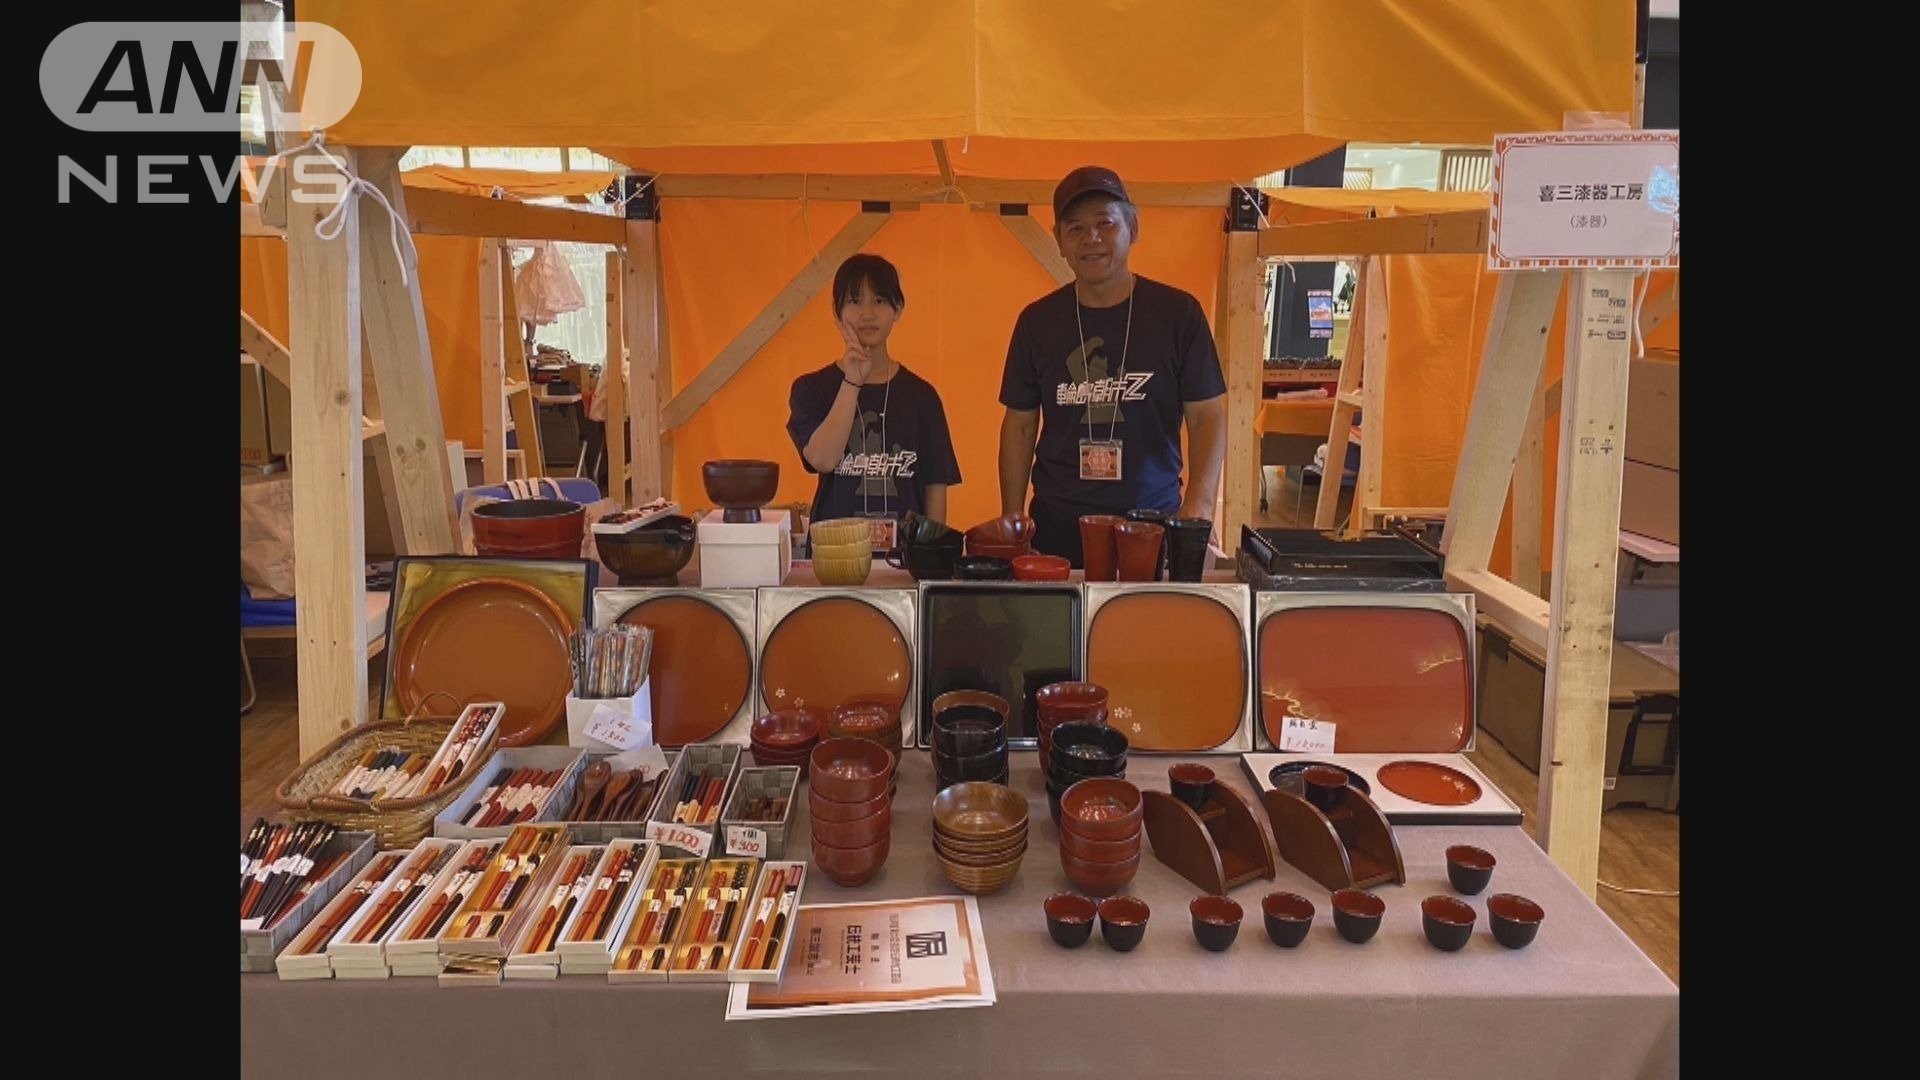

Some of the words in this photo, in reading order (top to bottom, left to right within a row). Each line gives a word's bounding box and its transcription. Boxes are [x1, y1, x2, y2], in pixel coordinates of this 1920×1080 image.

[1539, 183, 1644, 202] 喜三漆器工房
